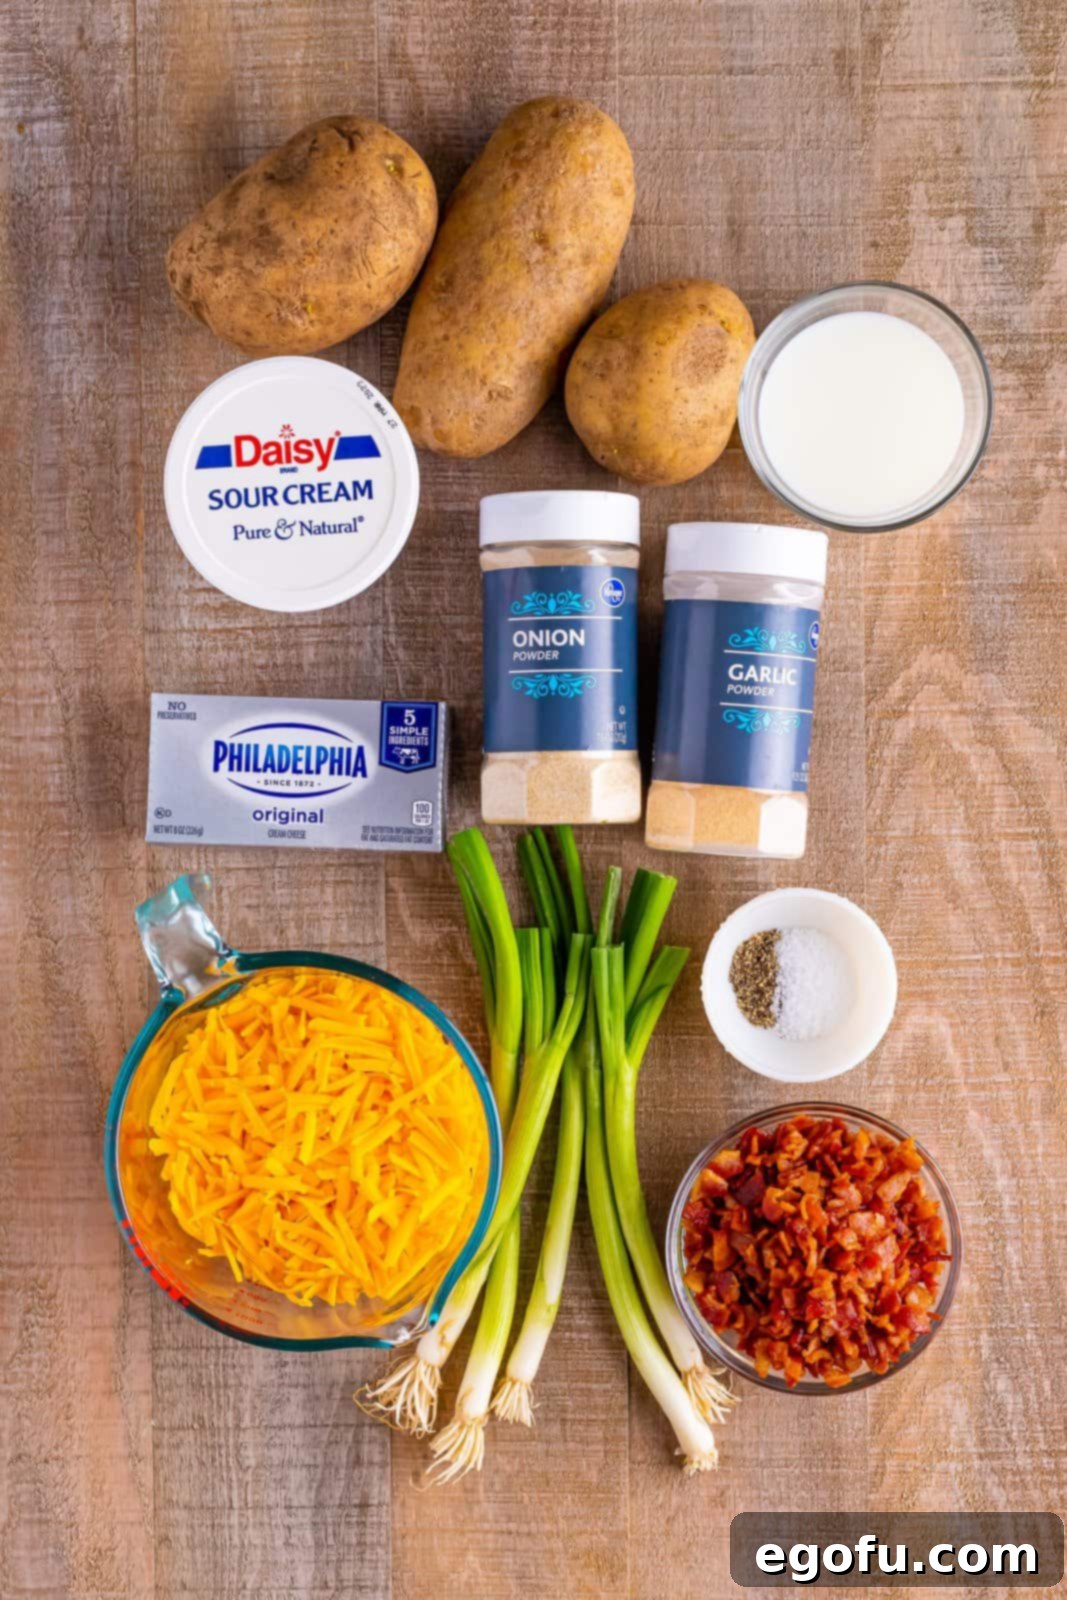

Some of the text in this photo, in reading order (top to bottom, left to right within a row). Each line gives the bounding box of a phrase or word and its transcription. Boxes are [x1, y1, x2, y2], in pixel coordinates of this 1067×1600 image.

[234, 430, 336, 472] Daisy
[208, 479, 374, 511] SOUR CREAM
[232, 524, 271, 541] Pure
[274, 518, 296, 541] &
[512, 629, 586, 648] ONION
[513, 650, 560, 661] POWDER
[727, 663, 797, 686] GARLIC
[726, 684, 775, 697] POWDER
[167, 701, 187, 711] NO
[404, 709, 416, 726] 5
[389, 726, 429, 736] SIMPLE
[212, 739, 368, 779] PHILADELPHIA
[263, 778, 315, 788] SINCE 1872
[252, 806, 324, 825] original
[415, 803, 430, 814] 100
